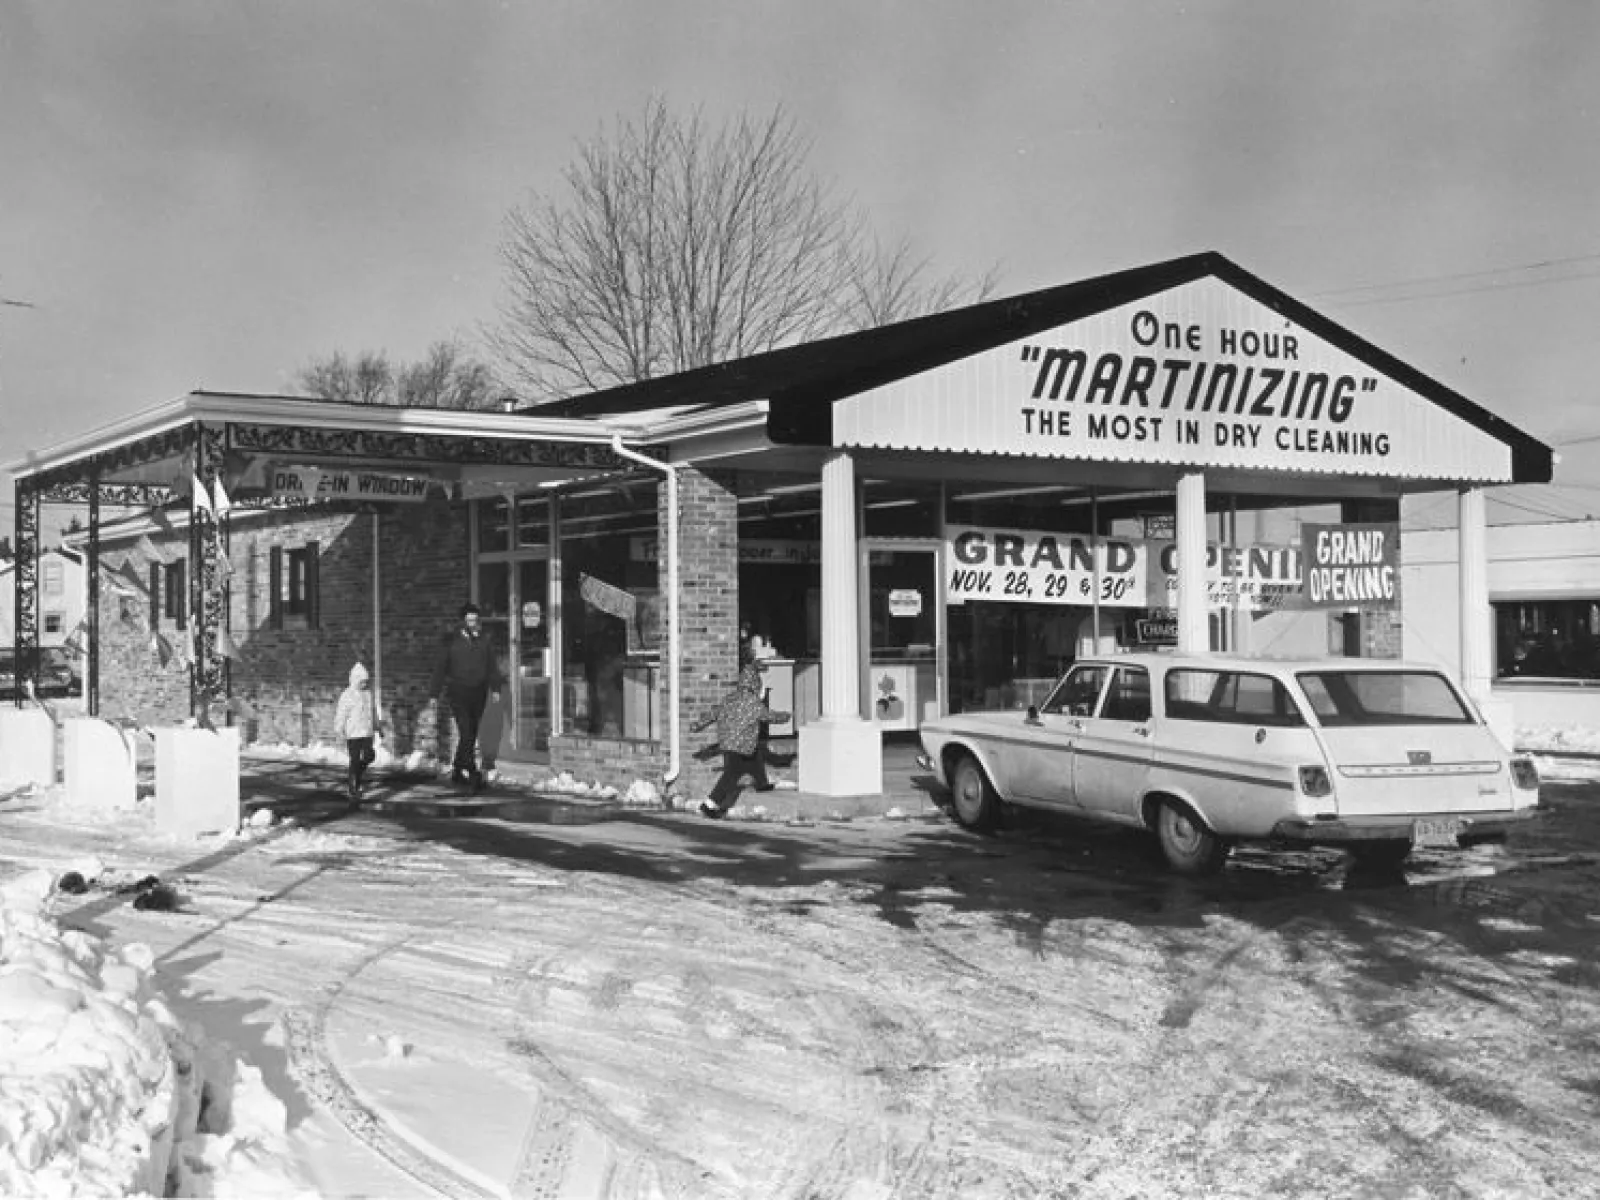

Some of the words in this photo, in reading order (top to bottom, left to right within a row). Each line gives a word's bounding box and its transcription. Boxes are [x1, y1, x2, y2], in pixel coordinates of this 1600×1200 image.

[1220, 328, 1299, 360] HOUR
[1021, 408, 1071, 436] THE
[1087, 413, 1163, 442] MOST
[1177, 418, 1199, 445] IN
[1214, 422, 1262, 448] DRY
[1275, 425, 1391, 456] CLEANING
[275, 473, 350, 493] DRIE-IN
[357, 475, 427, 496] WINDOW
[953, 531, 1136, 573] GRAND
[1316, 530, 1384, 564] GRAND
[951, 569, 992, 593] NOV.
[1003, 571, 1034, 598] 28,
[1044, 573, 1068, 597] 29
[1310, 565, 1394, 602] OPENING
